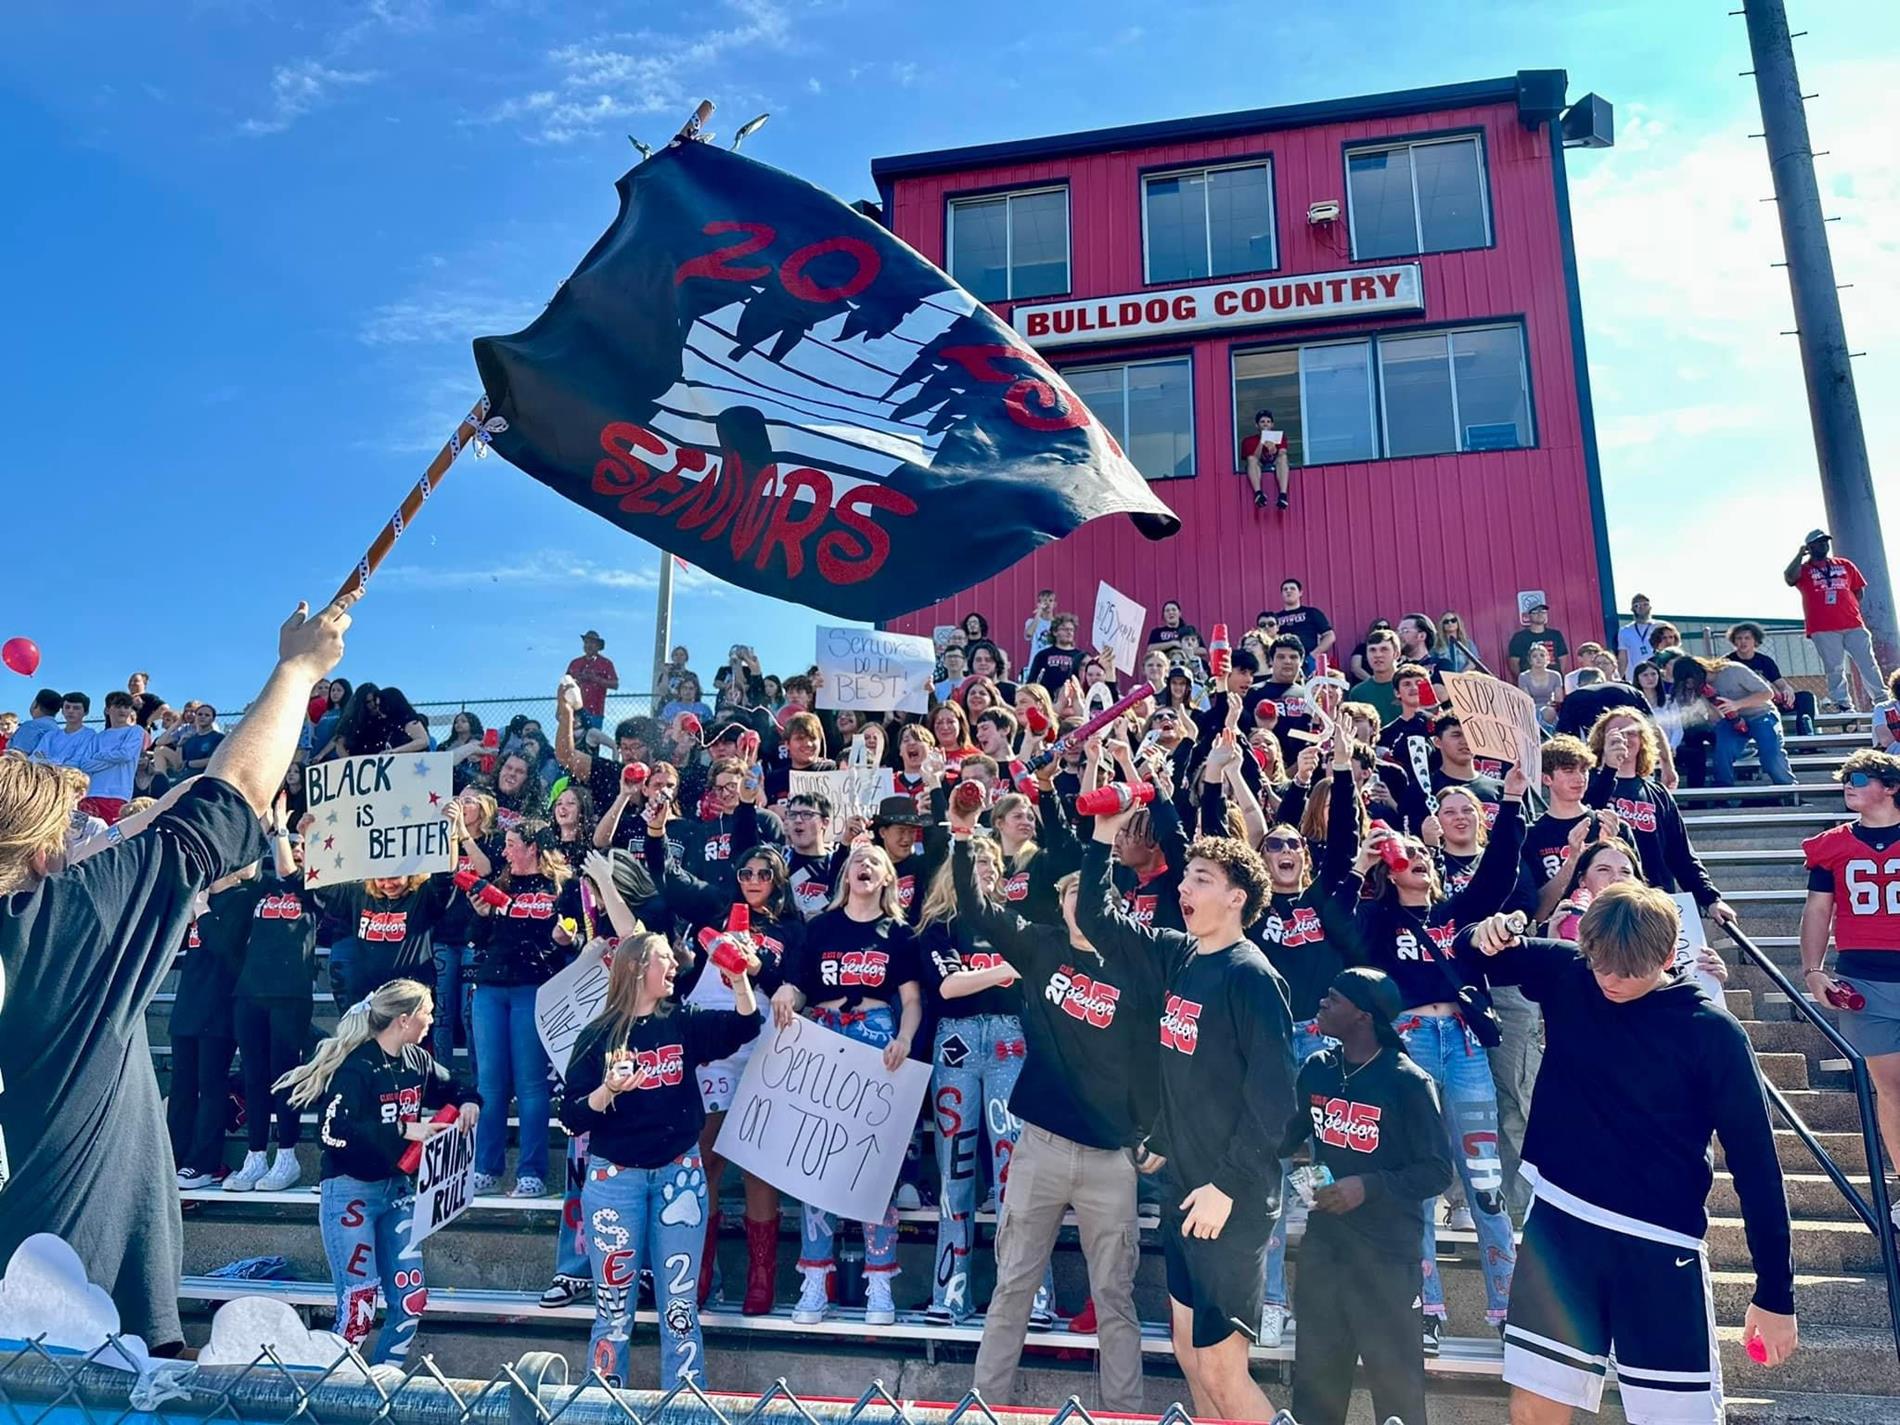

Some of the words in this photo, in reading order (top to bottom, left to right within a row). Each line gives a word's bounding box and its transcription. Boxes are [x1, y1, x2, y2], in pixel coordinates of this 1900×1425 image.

[674, 221, 881, 302] 20
[1026, 295, 1197, 337] BULLDOG
[1214, 272, 1403, 316] COUNTRY
[828, 628, 921, 658] Seniors
[854, 657, 871, 674] DO
[835, 672, 909, 703] BEST!
[1452, 678, 1497, 718] STOP
[1462, 715, 1486, 748] TO
[308, 756, 395, 807] BLACK
[356, 804, 374, 827] iS
[369, 820, 450, 859] BETTER
[510, 892, 557, 919] 25
[366, 911, 407, 942] 25
[1262, 915, 1284, 943] 20
[1396, 935, 1419, 960] 20
[821, 960, 838, 986] 20
[840, 951, 890, 987] 25
[840, 963, 886, 976] Senior
[1045, 972, 1071, 1005] 20
[1061, 973, 1120, 1029] 25
[1066, 986, 1116, 1016] Senior
[1160, 995, 1203, 1055] 25
[637, 1044, 684, 1090] 25
[762, 1017, 894, 1126] Seniors
[702, 1077, 729, 1095] 25
[786, 1103, 849, 1181] TOP
[1310, 1106, 1323, 1140] 20
[1322, 1098, 1381, 1153] 25
[1324, 1115, 1379, 1138] Senior
